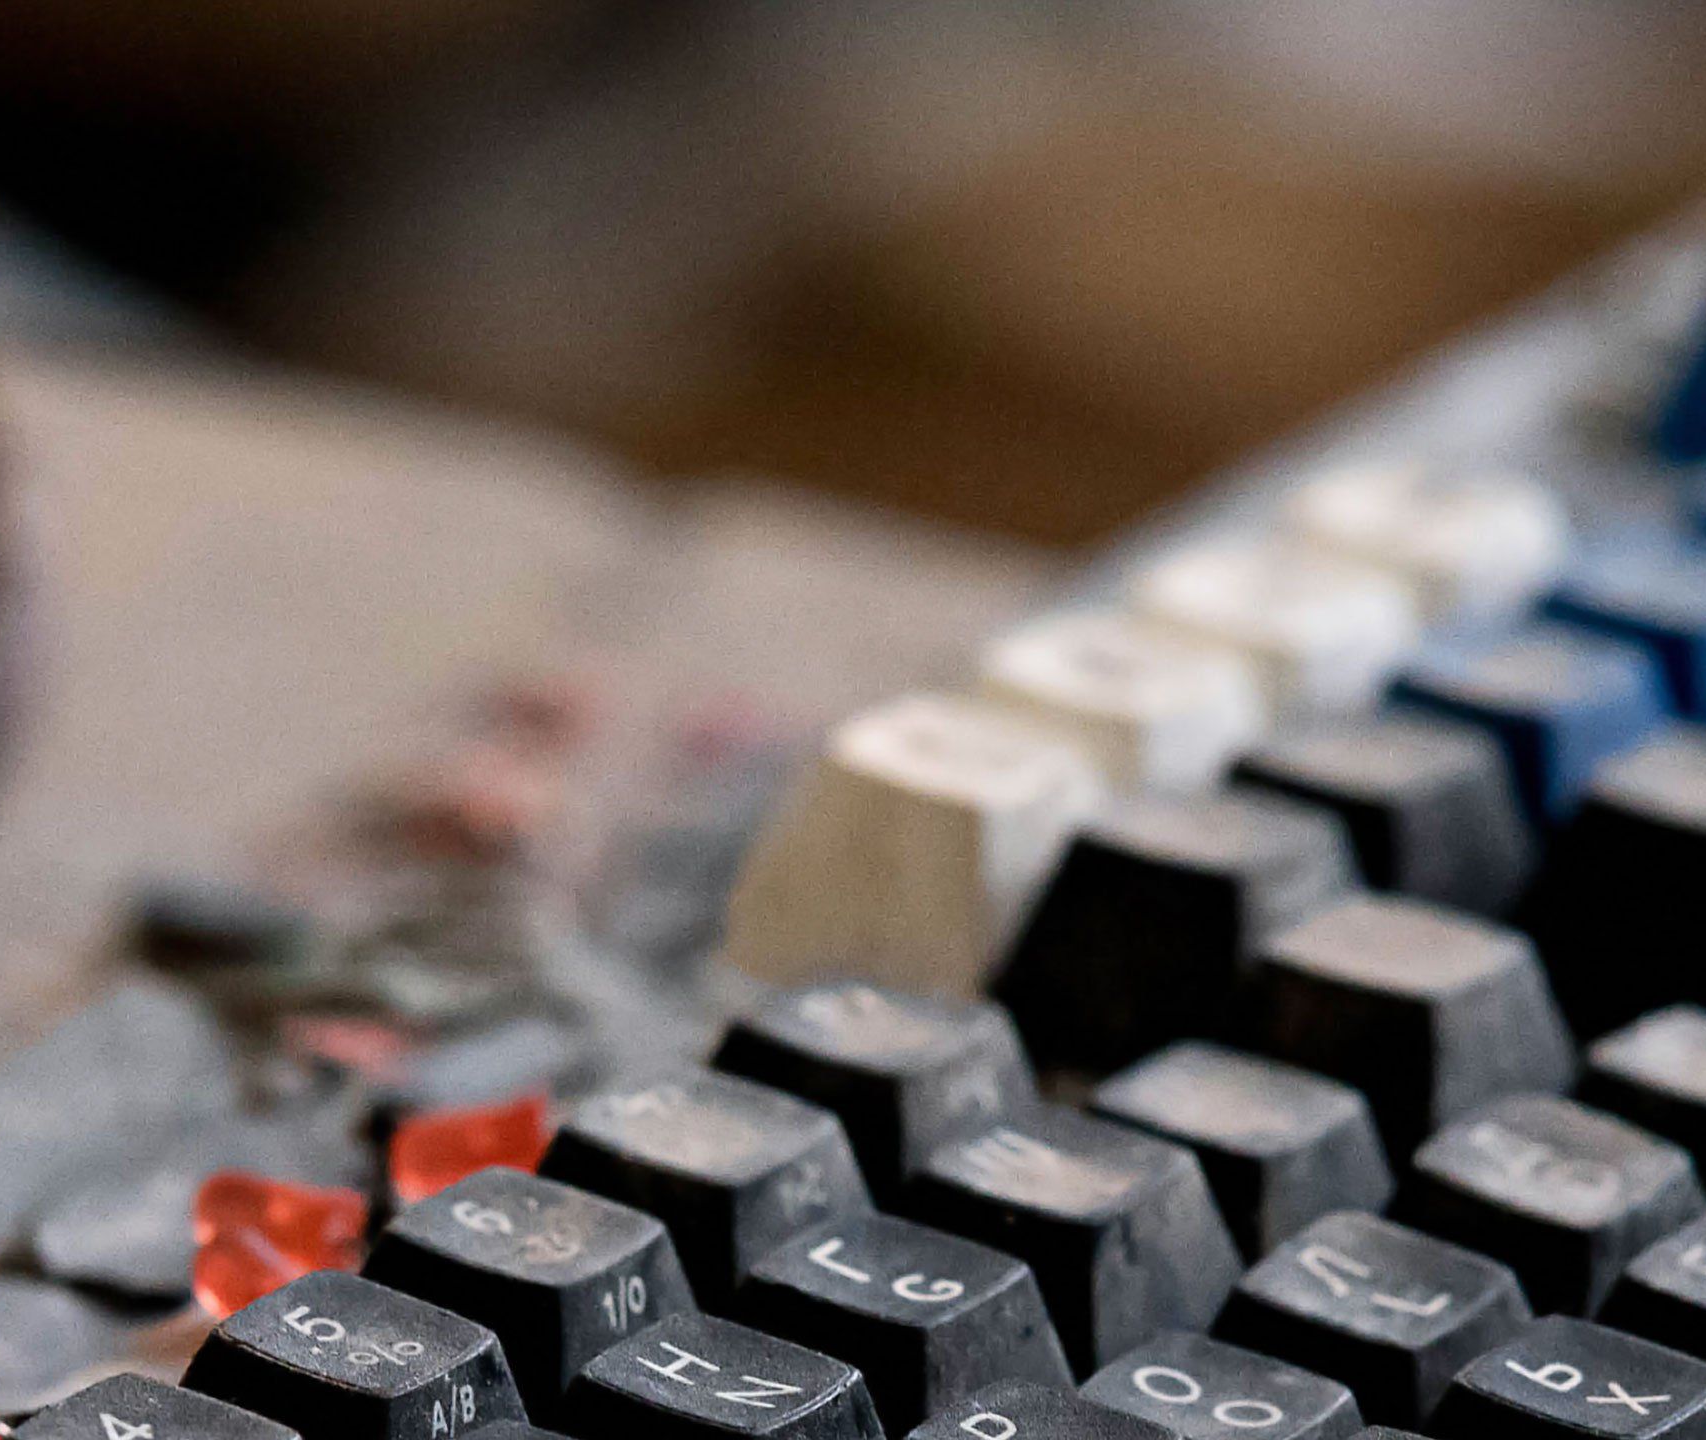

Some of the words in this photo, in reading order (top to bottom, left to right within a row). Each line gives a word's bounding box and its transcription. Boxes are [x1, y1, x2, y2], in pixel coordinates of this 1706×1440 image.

[451, 1200, 512, 1237] 6
[807, 1236, 872, 1284] Г
[1297, 1244, 1372, 1298] Л
[891, 1272, 965, 1303] G
[1370, 1291, 1453, 1317] L
[282, 1305, 347, 1342] 5
[347, 1340, 425, 1367] %
[637, 1341, 721, 1386] Н
[714, 1374, 803, 1409] N
[1132, 1364, 1202, 1404] О
[1585, 1380, 1672, 1415] X
[430, 1383, 477, 1440] A/B
[1212, 1399, 1284, 1429] O
